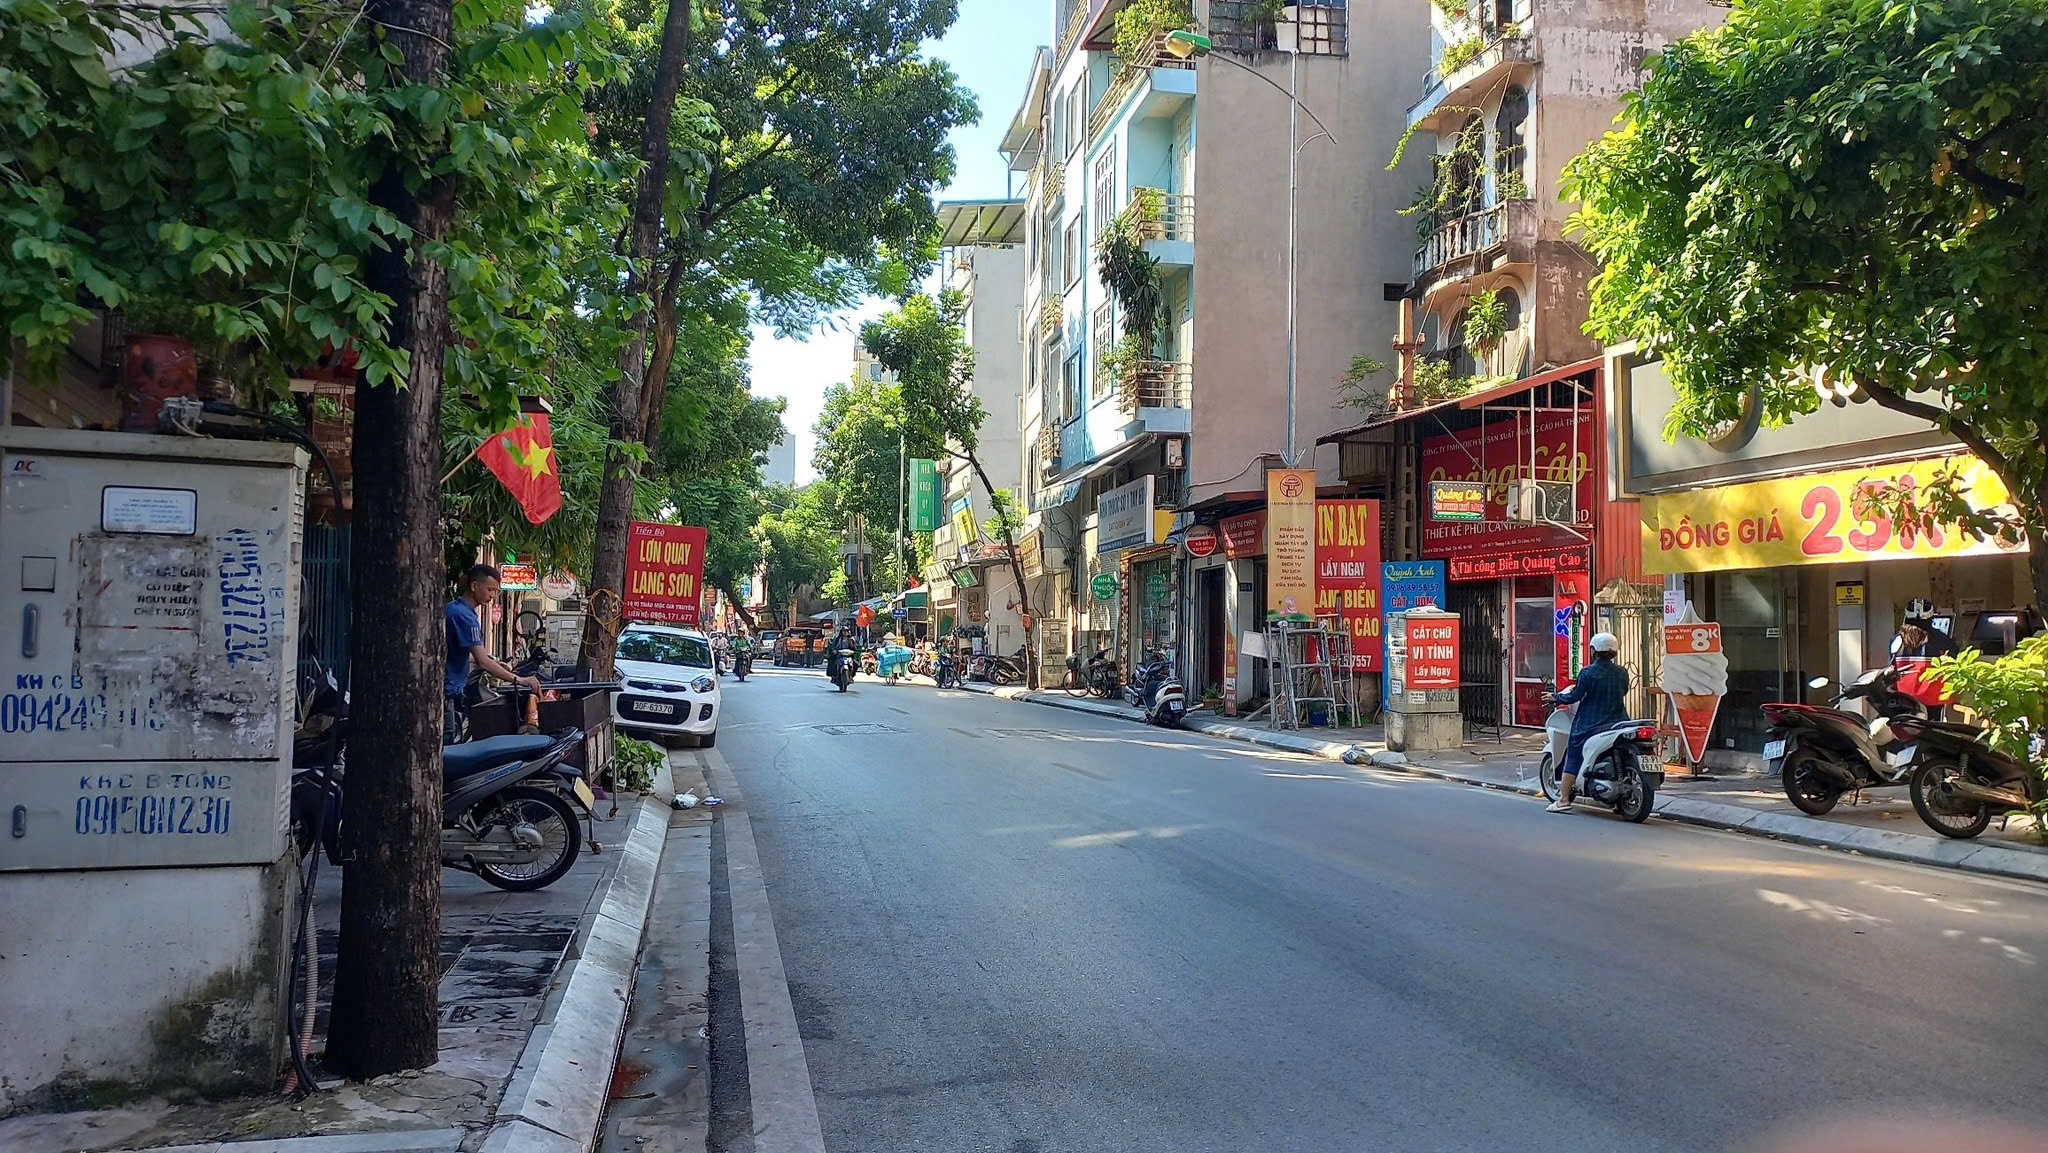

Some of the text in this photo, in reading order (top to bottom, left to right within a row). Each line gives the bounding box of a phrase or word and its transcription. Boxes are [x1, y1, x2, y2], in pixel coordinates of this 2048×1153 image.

[1566, 414, 1590, 426] THNH
[1318, 504, 1367, 558] IN BẠT
[1425, 522, 1448, 540] THIẾT
[1660, 508, 1784, 552] ĐỒNG GIÁ
[640, 539, 691, 567] LỢN QUAY
[1458, 562, 1472, 574] Thi
[1474, 560, 1495, 575] công
[1499, 553, 1519, 571] Biển
[1522, 555, 1556, 571] Quảng
[1559, 553, 1581, 567] Cáo
[1321, 558, 1365, 577] LẤY NGAY
[633, 570, 694, 599] LẠNG SƠN
[1344, 582, 1375, 609] BIỂN
[1354, 613, 1380, 637] CÁO
[1413, 624, 1452, 640] CẮT CHỮ
[1413, 643, 1453, 660] VI TÍNH
[1414, 665, 1451, 677] Lấy Ngay
